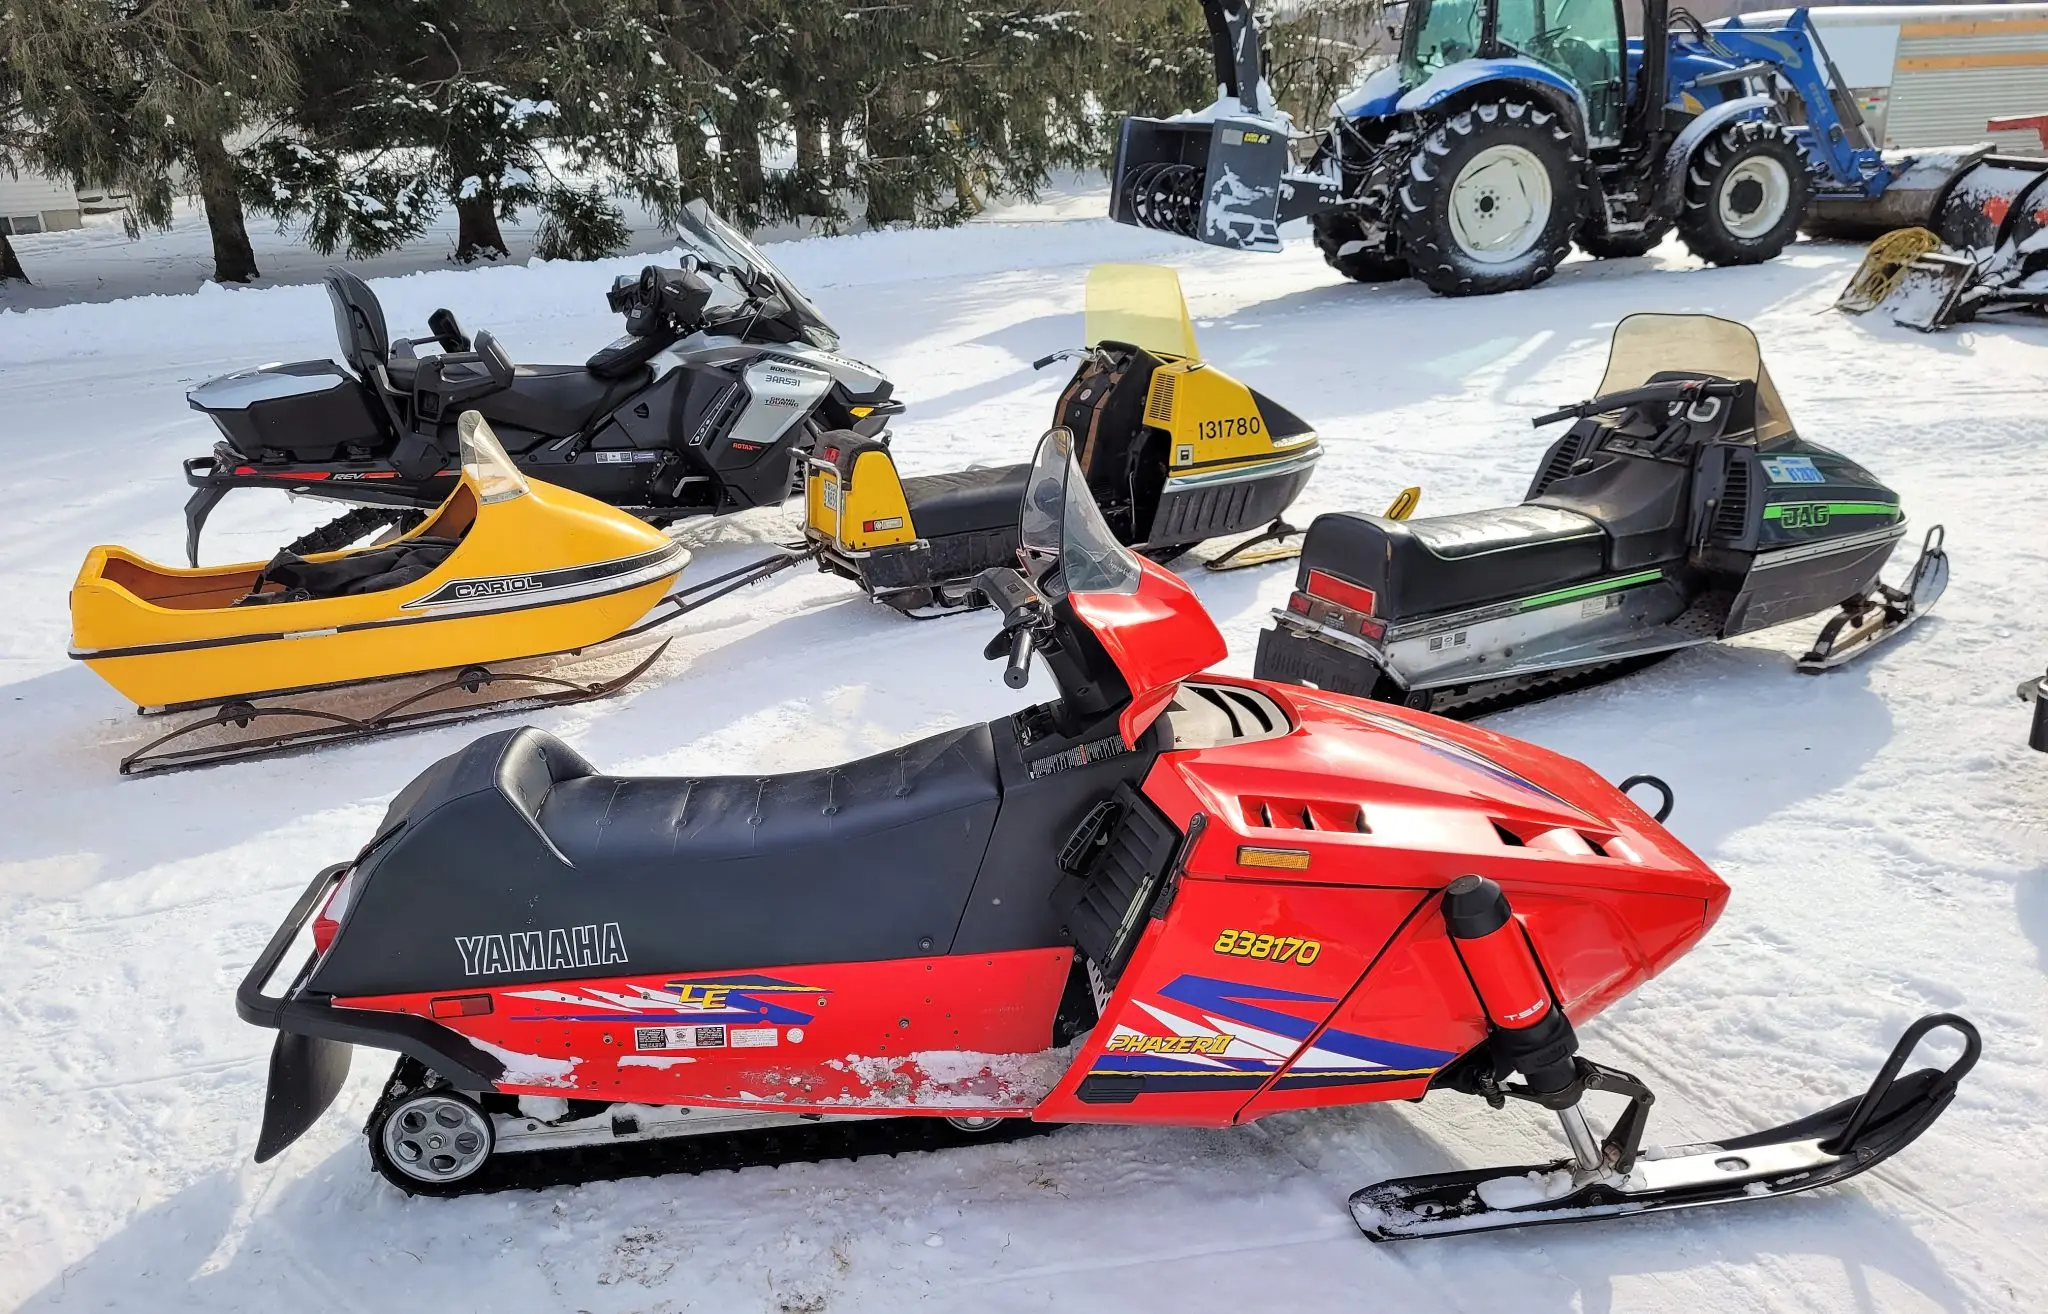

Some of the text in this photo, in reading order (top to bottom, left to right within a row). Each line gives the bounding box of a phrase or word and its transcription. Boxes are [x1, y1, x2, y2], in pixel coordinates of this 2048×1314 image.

[765, 374, 801, 387] 3AR531
[1198, 416, 1261, 441] 131780
[332, 472, 366, 481] REV
[1781, 504, 1831, 529] JAG
[455, 576, 543, 599] CARIOL
[454, 921, 629, 976] YAMAHA
[1212, 929, 1322, 967] 838170
[679, 983, 732, 1010] LE
